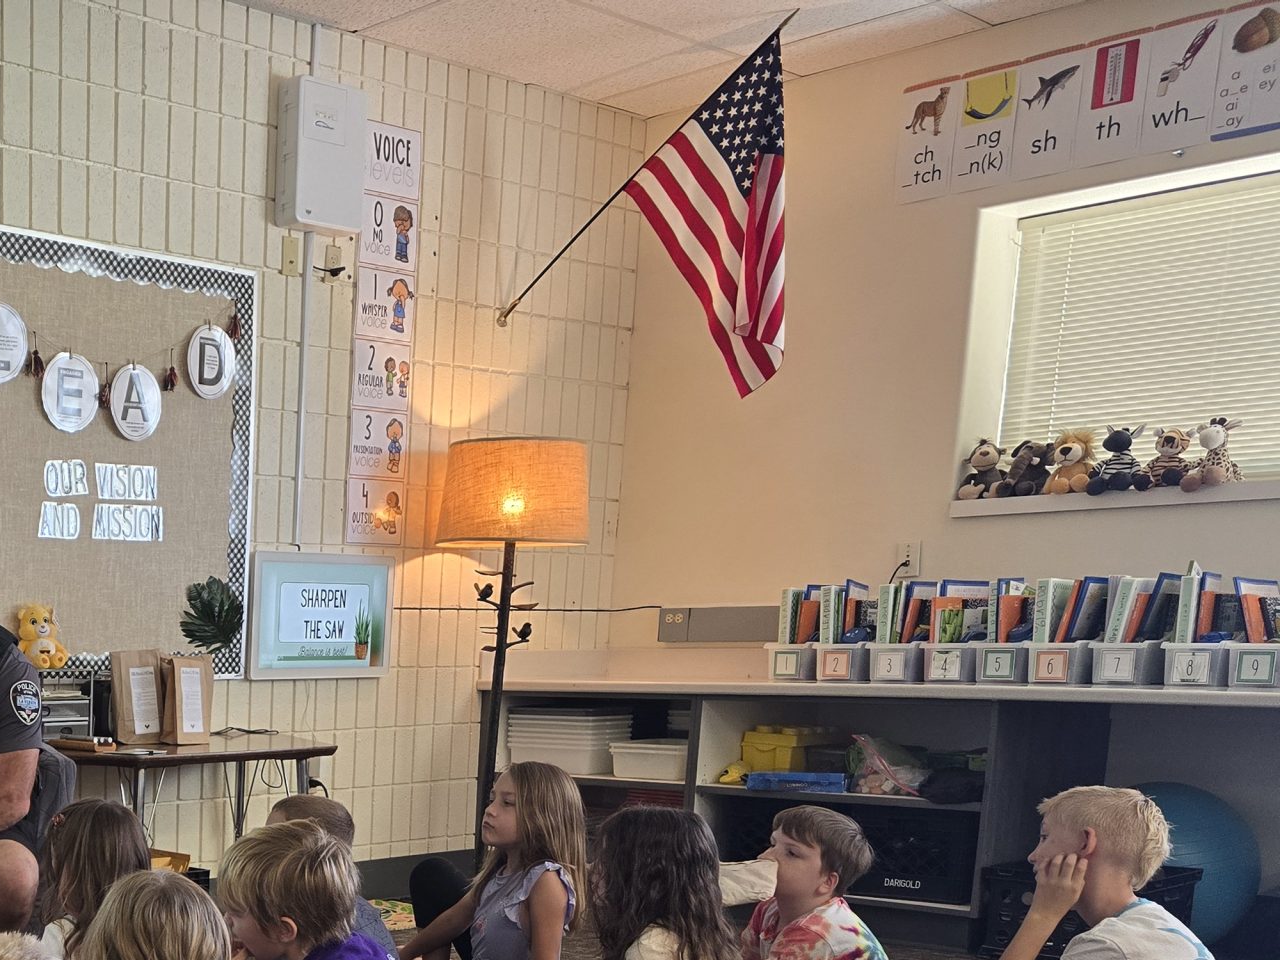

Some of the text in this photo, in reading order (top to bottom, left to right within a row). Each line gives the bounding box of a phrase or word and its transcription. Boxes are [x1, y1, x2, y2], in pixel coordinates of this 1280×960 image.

[1231, 70, 1241, 80] a
[1262, 60, 1277, 74] ei
[1258, 77, 1277, 91] ey
[1225, 98, 1239, 112] ai
[1095, 115, 1121, 140] th
[373, 131, 411, 167] VOICE
[1031, 129, 1057, 155] sh
[914, 145, 934, 165] ch
[370, 160, 414, 188] levels
[374, 200, 384, 228] 0
[372, 227, 383, 243] NO
[364, 240, 391, 256] voice
[361, 302, 388, 318] WHISPER
[360, 315, 387, 329] voice
[367, 344, 376, 371] 2
[57, 367, 84, 418] E
[121, 372, 149, 422] A
[198, 336, 224, 386] D
[357, 373, 384, 388] REGULAR
[358, 386, 383, 399] voice
[363, 414, 373, 440] 3
[355, 454, 380, 468] voice
[45, 461, 157, 498] OUR VISION
[362, 482, 369, 508] 4
[40, 503, 162, 540] AND MISSION
[351, 523, 376, 536] voice
[300, 588, 347, 608] SHARPEN
[304, 620, 345, 639] THE SAW
[297, 645, 325, 657] Balance
[833, 657, 839, 672] 2
[886, 658, 892, 673] 3
[941, 657, 948, 673] 4
[994, 656, 1001, 672] 5
[1047, 657, 1054, 675] 6
[1113, 656, 1121, 673] 7
[1186, 658, 1193, 676] 8
[1252, 658, 1259, 676] 9
[17, 683, 37, 693] POLICE
[884, 877, 921, 889] DARIGOLD
